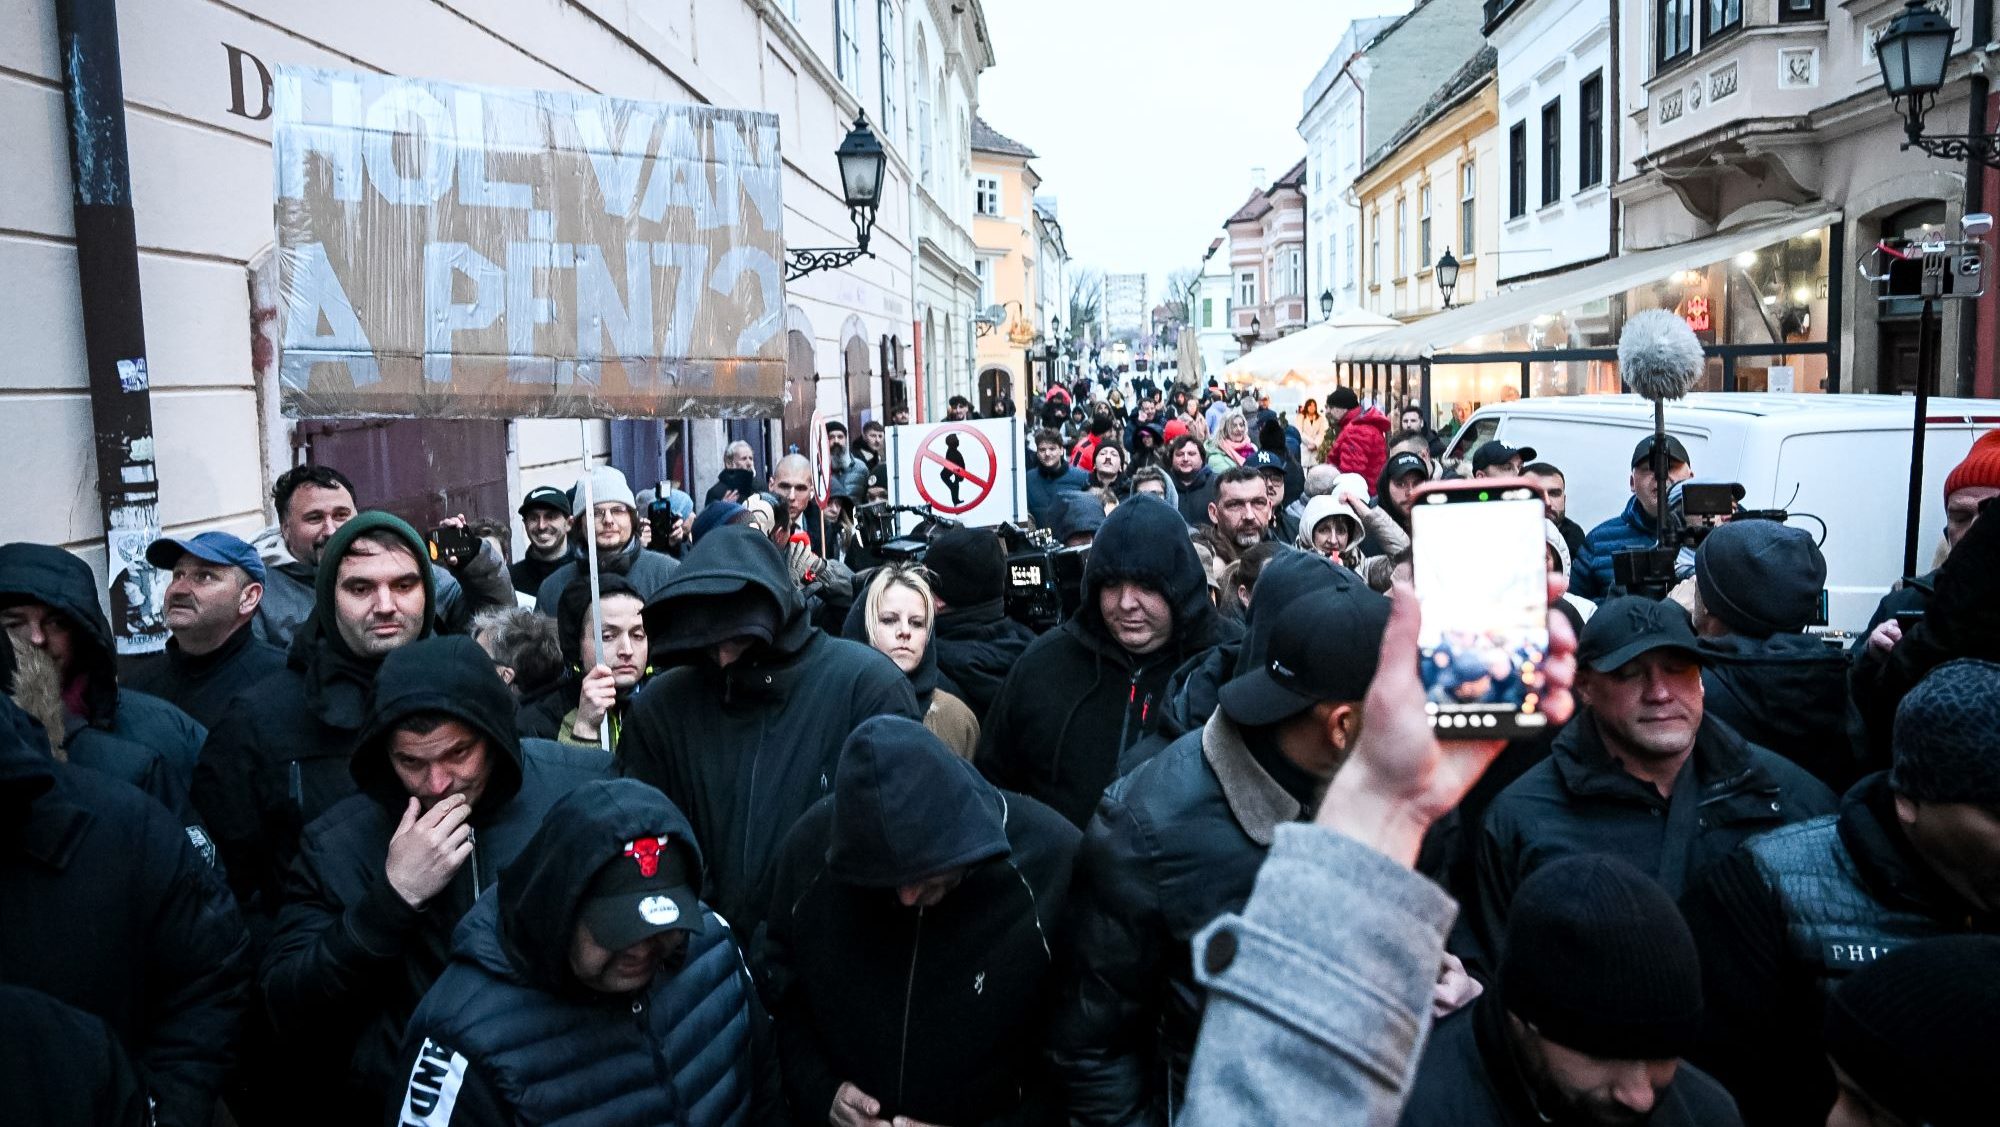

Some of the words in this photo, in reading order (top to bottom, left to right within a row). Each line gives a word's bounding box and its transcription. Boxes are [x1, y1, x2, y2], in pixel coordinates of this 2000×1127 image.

[273, 76, 533, 208] HOL
[573, 108, 780, 231] VAN
[277, 241, 382, 391] A
[1832, 944, 1888, 961] PHI
